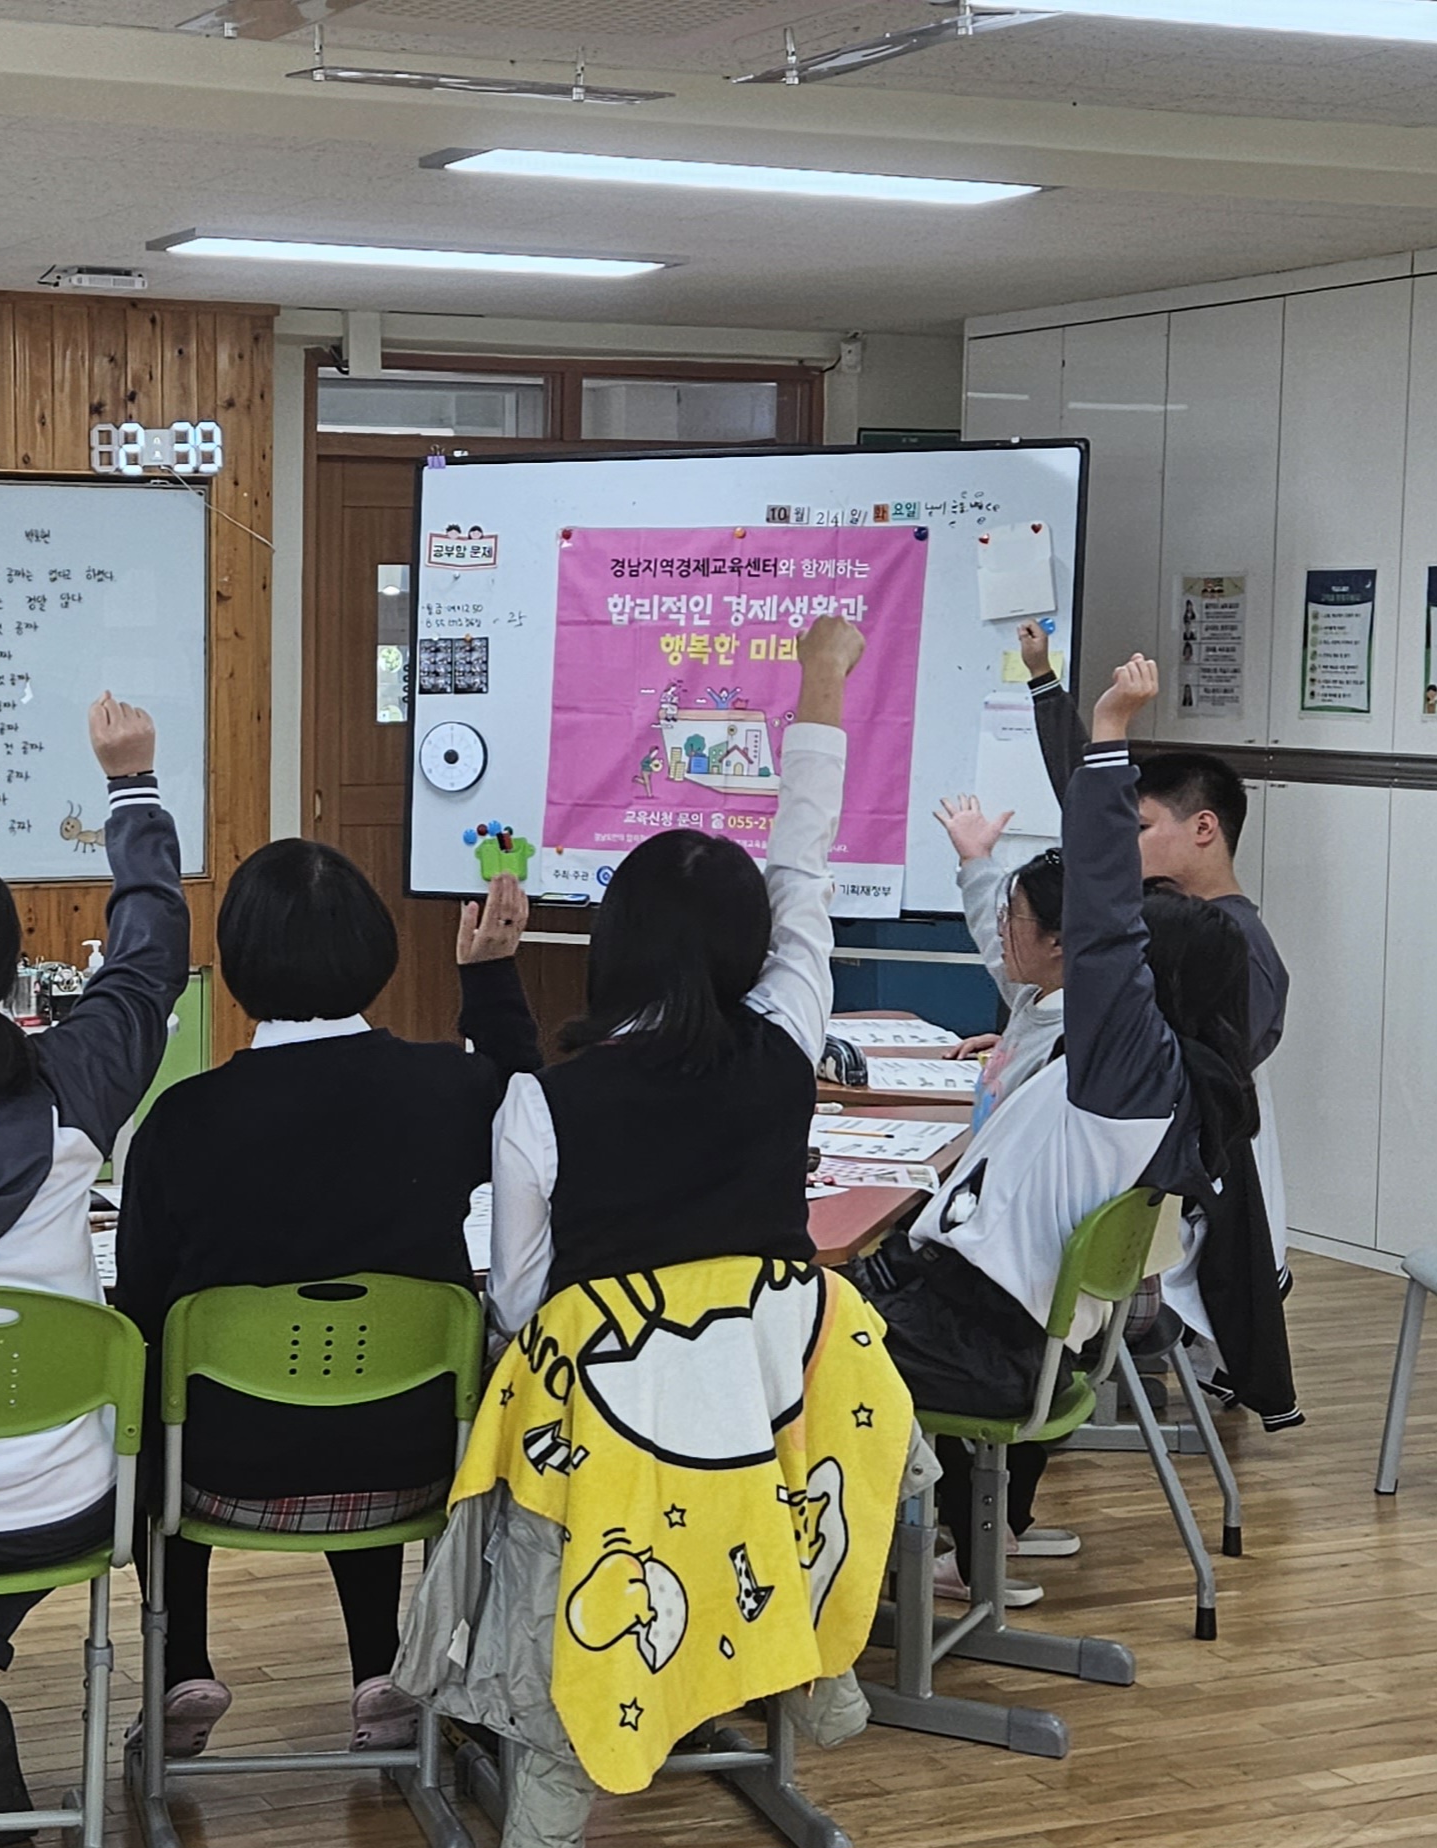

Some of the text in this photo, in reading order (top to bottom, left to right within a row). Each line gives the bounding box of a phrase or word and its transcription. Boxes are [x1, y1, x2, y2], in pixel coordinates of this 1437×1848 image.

[470, 545, 493, 558] 문제
[802, 558, 871, 579] 함께하는
[607, 593, 712, 627] 합리적인
[15, 621, 39, 636] 공짜
[660, 633, 740, 666] 행복한
[10, 672, 31, 686] 공짜
[0, 722, 19, 736] 공짜
[4, 743, 13, 755] 것
[22, 741, 44, 755] 공짜
[6, 769, 31, 783] 공짜
[623, 811, 672, 828] 교육신청
[677, 812, 704, 828] 문의
[9, 819, 32, 836] 공짜
[839, 884, 892, 898] 기획재정부
